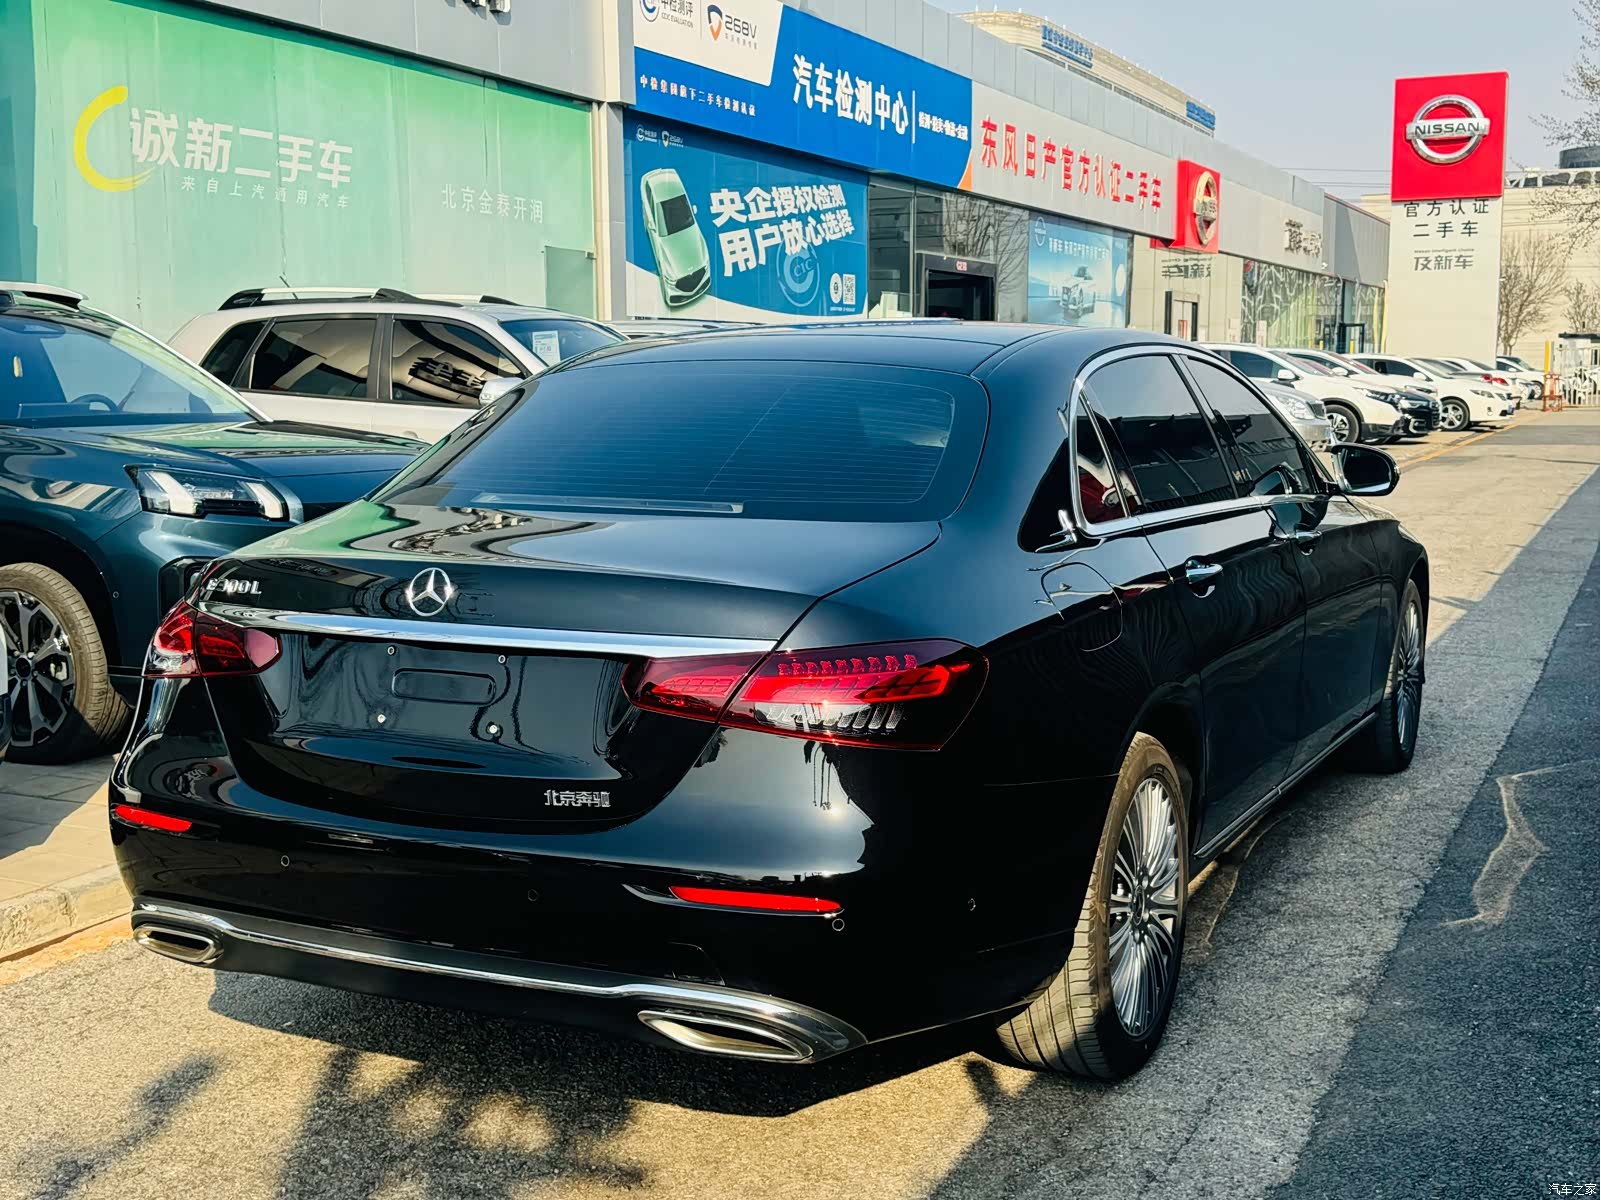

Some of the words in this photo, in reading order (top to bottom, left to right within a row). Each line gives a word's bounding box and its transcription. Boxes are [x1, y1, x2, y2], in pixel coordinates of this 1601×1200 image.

[725, 14, 757, 39] 268V
[792, 53, 909, 135] 汽车检测中心
[1414, 121, 1481, 136] NISSAN
[129, 107, 353, 189] 诚新二手车
[981, 114, 1162, 213] 东风日产官方认证二手车
[181, 176, 350, 209] 来自上汽通用汽车
[441, 183, 543, 224] 北京金泰开润
[710, 184, 847, 228] 央企授权检测
[1404, 199, 1490, 218] 官方认证
[718, 209, 855, 277] 用户放心选择
[1413, 220, 1479, 238] 二手车
[1414, 254, 1474, 271] 及新车
[543, 789, 611, 808] 北京奔驰
